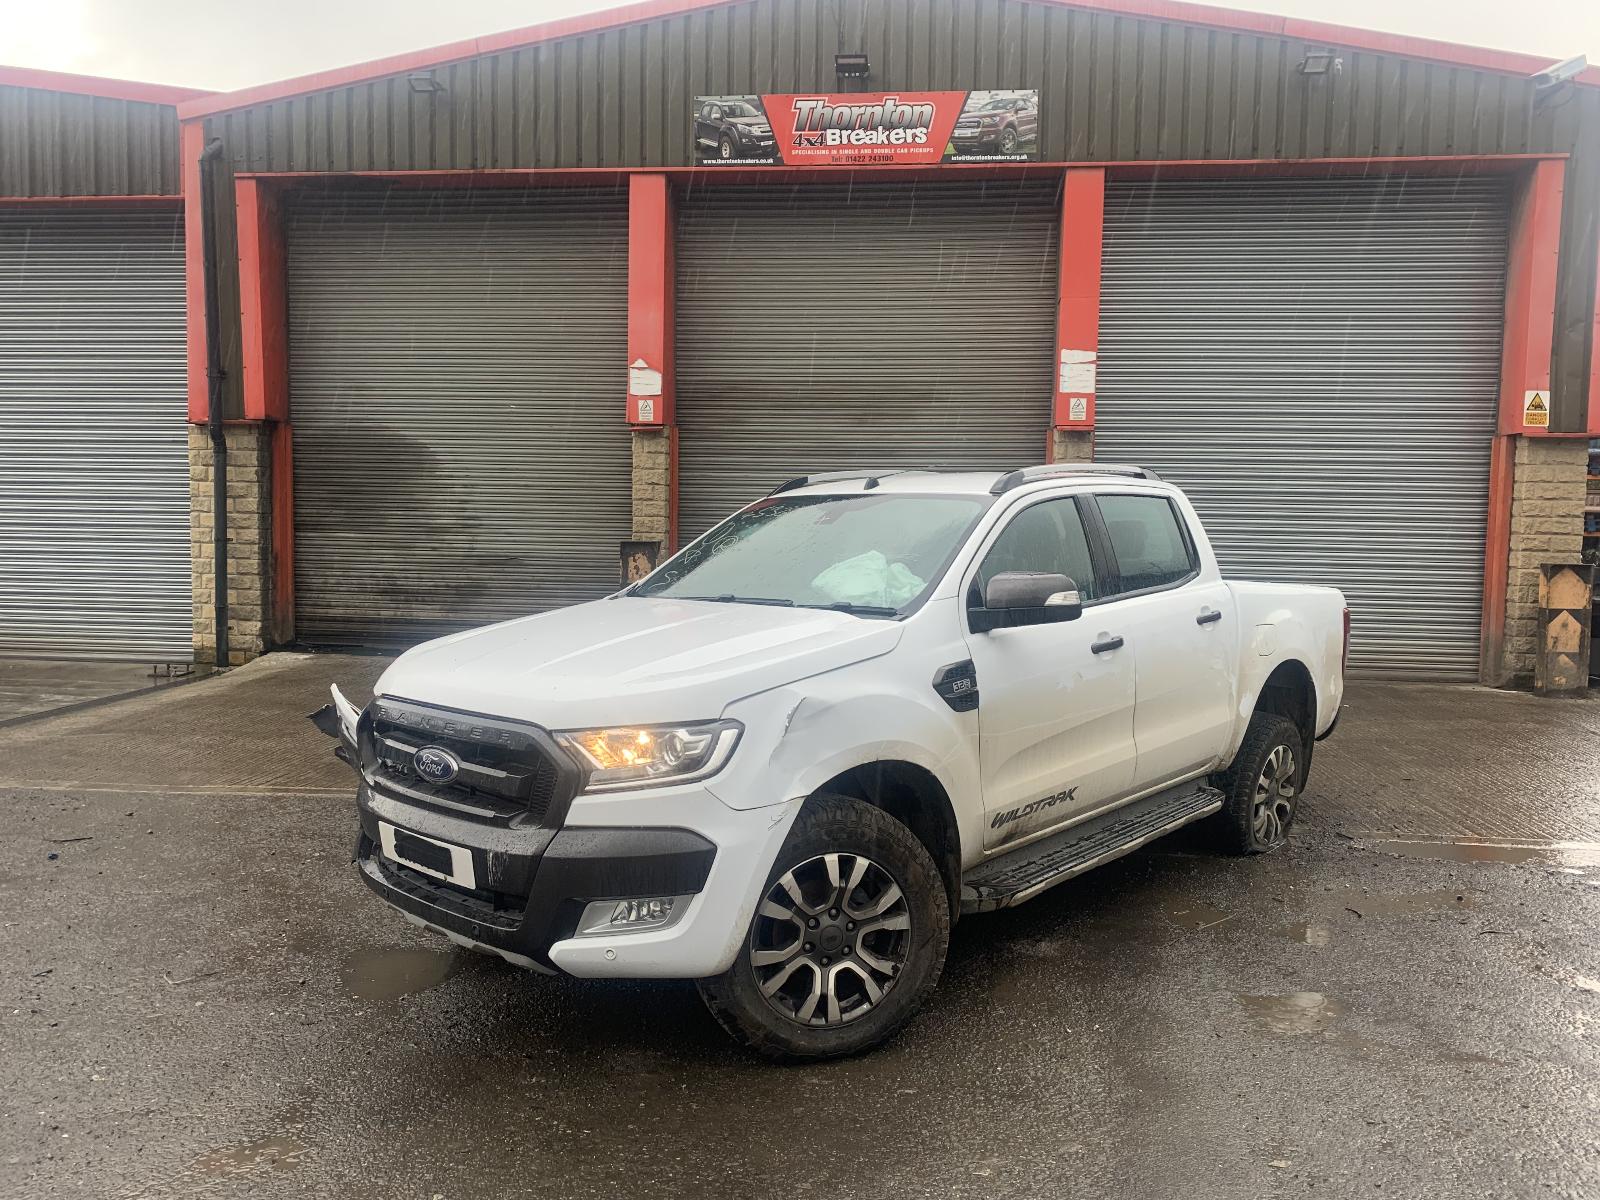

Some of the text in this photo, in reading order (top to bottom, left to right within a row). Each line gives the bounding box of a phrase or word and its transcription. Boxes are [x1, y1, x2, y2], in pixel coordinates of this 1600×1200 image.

[793, 97, 935, 132] Thornton
[792, 126, 928, 148] 4x4 Breakers
[418, 753, 445, 777] Ford
[990, 785, 1080, 830] WILDTRAK
